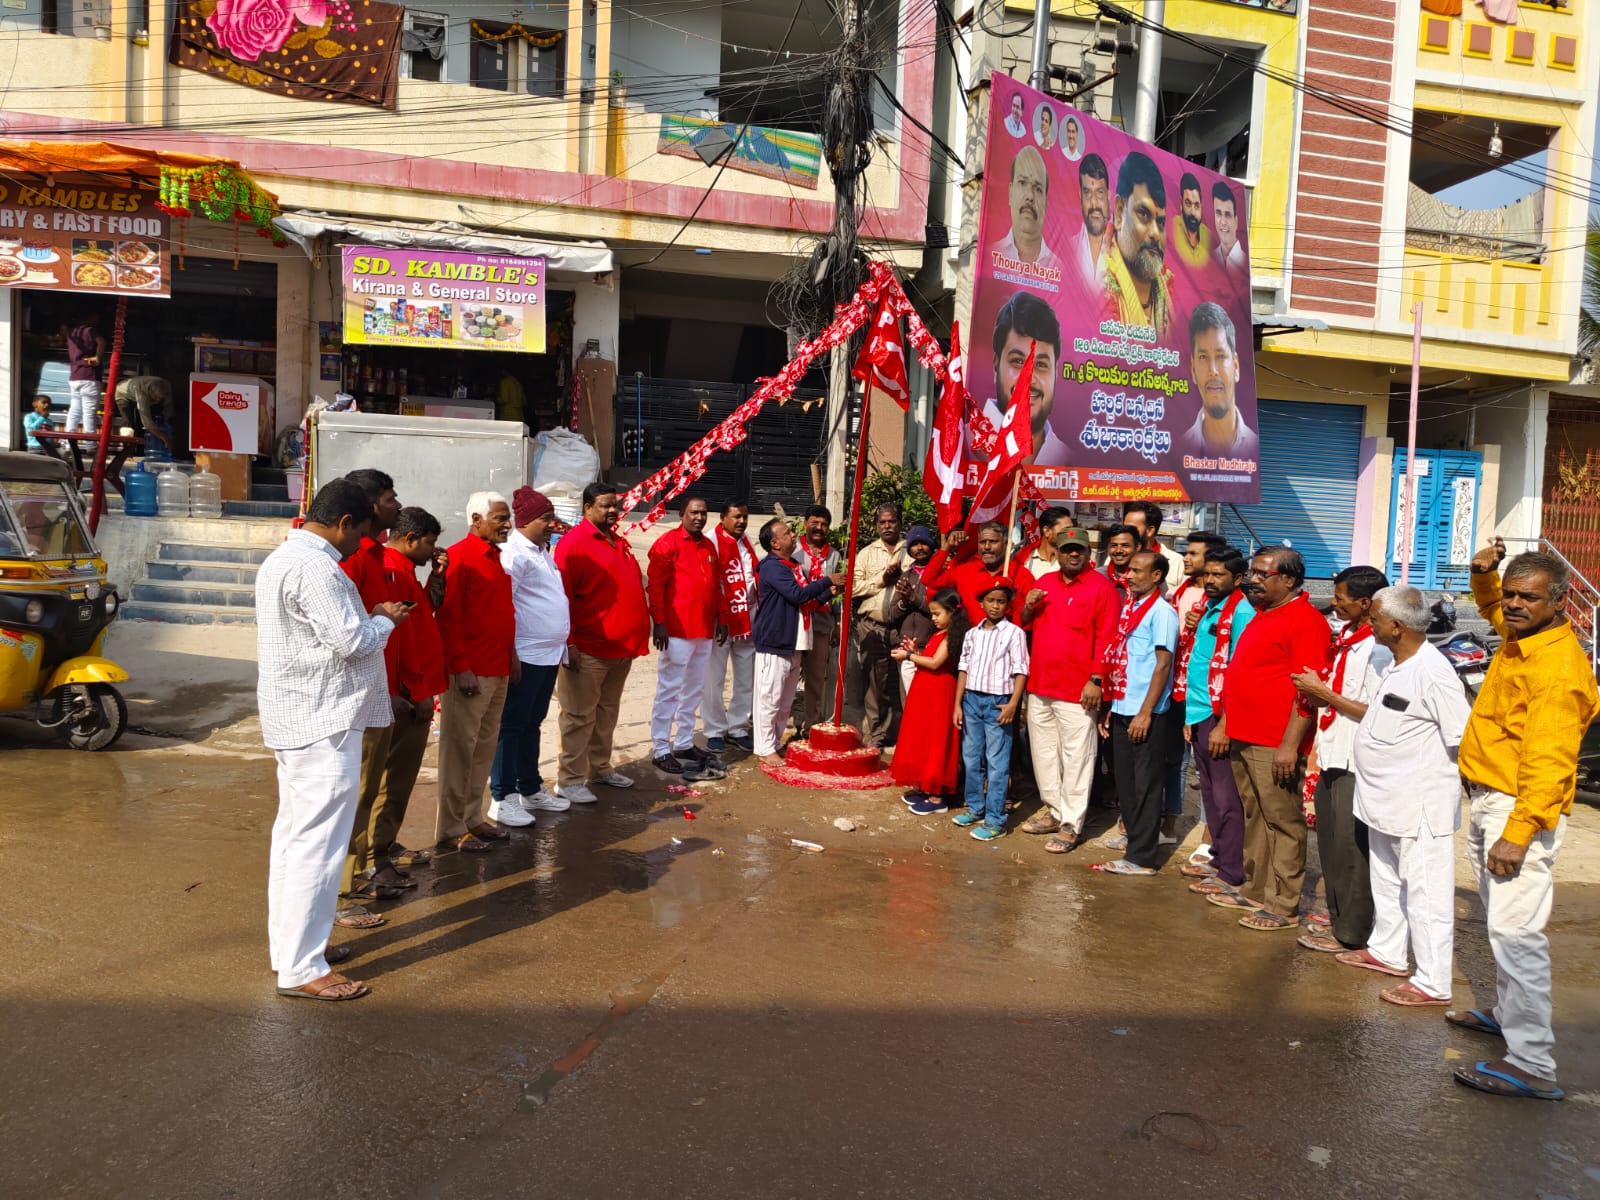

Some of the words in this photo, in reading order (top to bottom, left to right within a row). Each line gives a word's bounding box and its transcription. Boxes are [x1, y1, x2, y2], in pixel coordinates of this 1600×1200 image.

[17, 186, 142, 213] KAMBLES
[33, 214, 48, 229] &
[53, 213, 103, 233] FAST
[108, 216, 161, 237] FOOD
[353, 256, 396, 276] SD.
[405, 260, 538, 286] KAMBLE's
[992, 251, 1030, 275] Thourya
[1032, 262, 1061, 281] Nayak
[353, 278, 406, 296] Kirana
[412, 282, 423, 296] &
[429, 283, 490, 302] General
[496, 287, 537, 304] Store
[219, 391, 241, 401] Dairy
[219, 400, 247, 408] trends
[1184, 455, 1217, 469] Bhaskar
[1218, 457, 1257, 474] Mudhiraju
[727, 573, 744, 583] CPI
[731, 604, 748, 613] CPI
